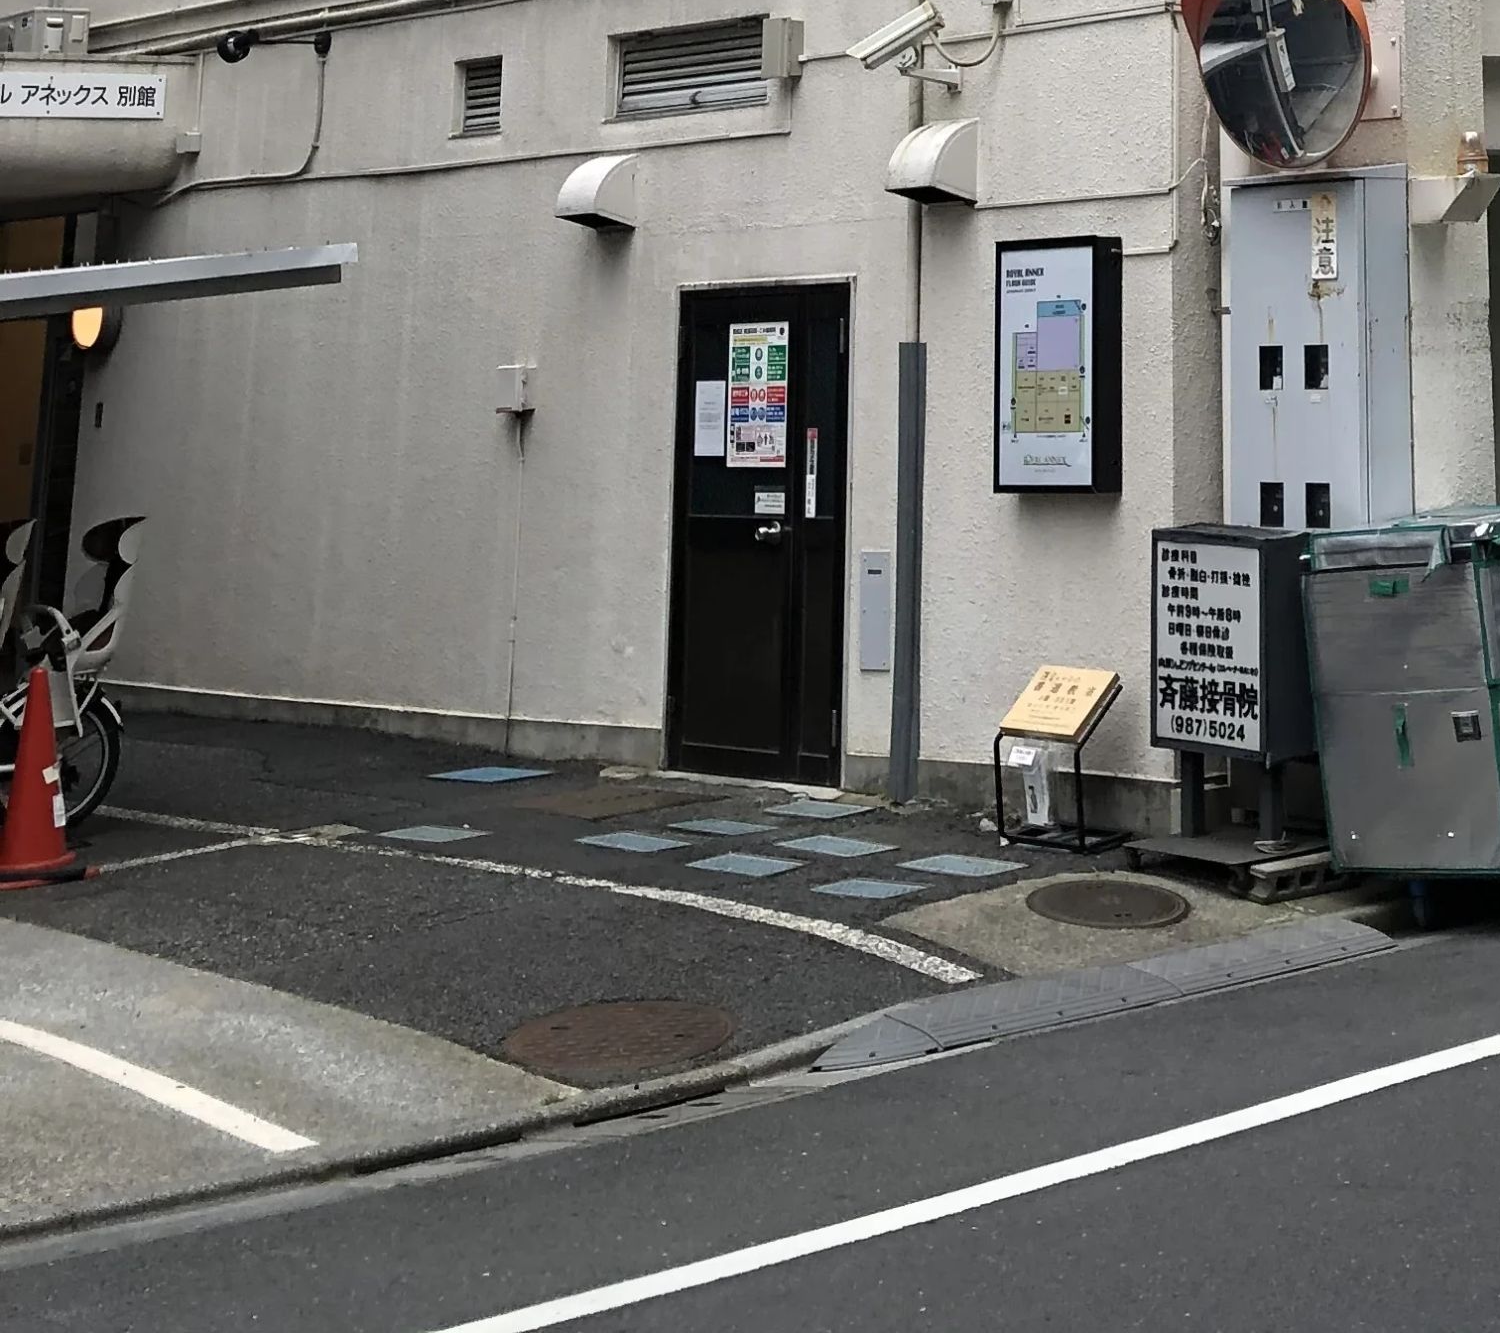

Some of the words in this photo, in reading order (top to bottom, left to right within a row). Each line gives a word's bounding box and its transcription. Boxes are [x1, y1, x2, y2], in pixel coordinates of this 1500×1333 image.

[21, 83, 109, 106] アネックス
[116, 85, 157, 108] 別館
[1313, 217, 1335, 275] 注意
[1171, 714, 1246, 742] (987)5024
